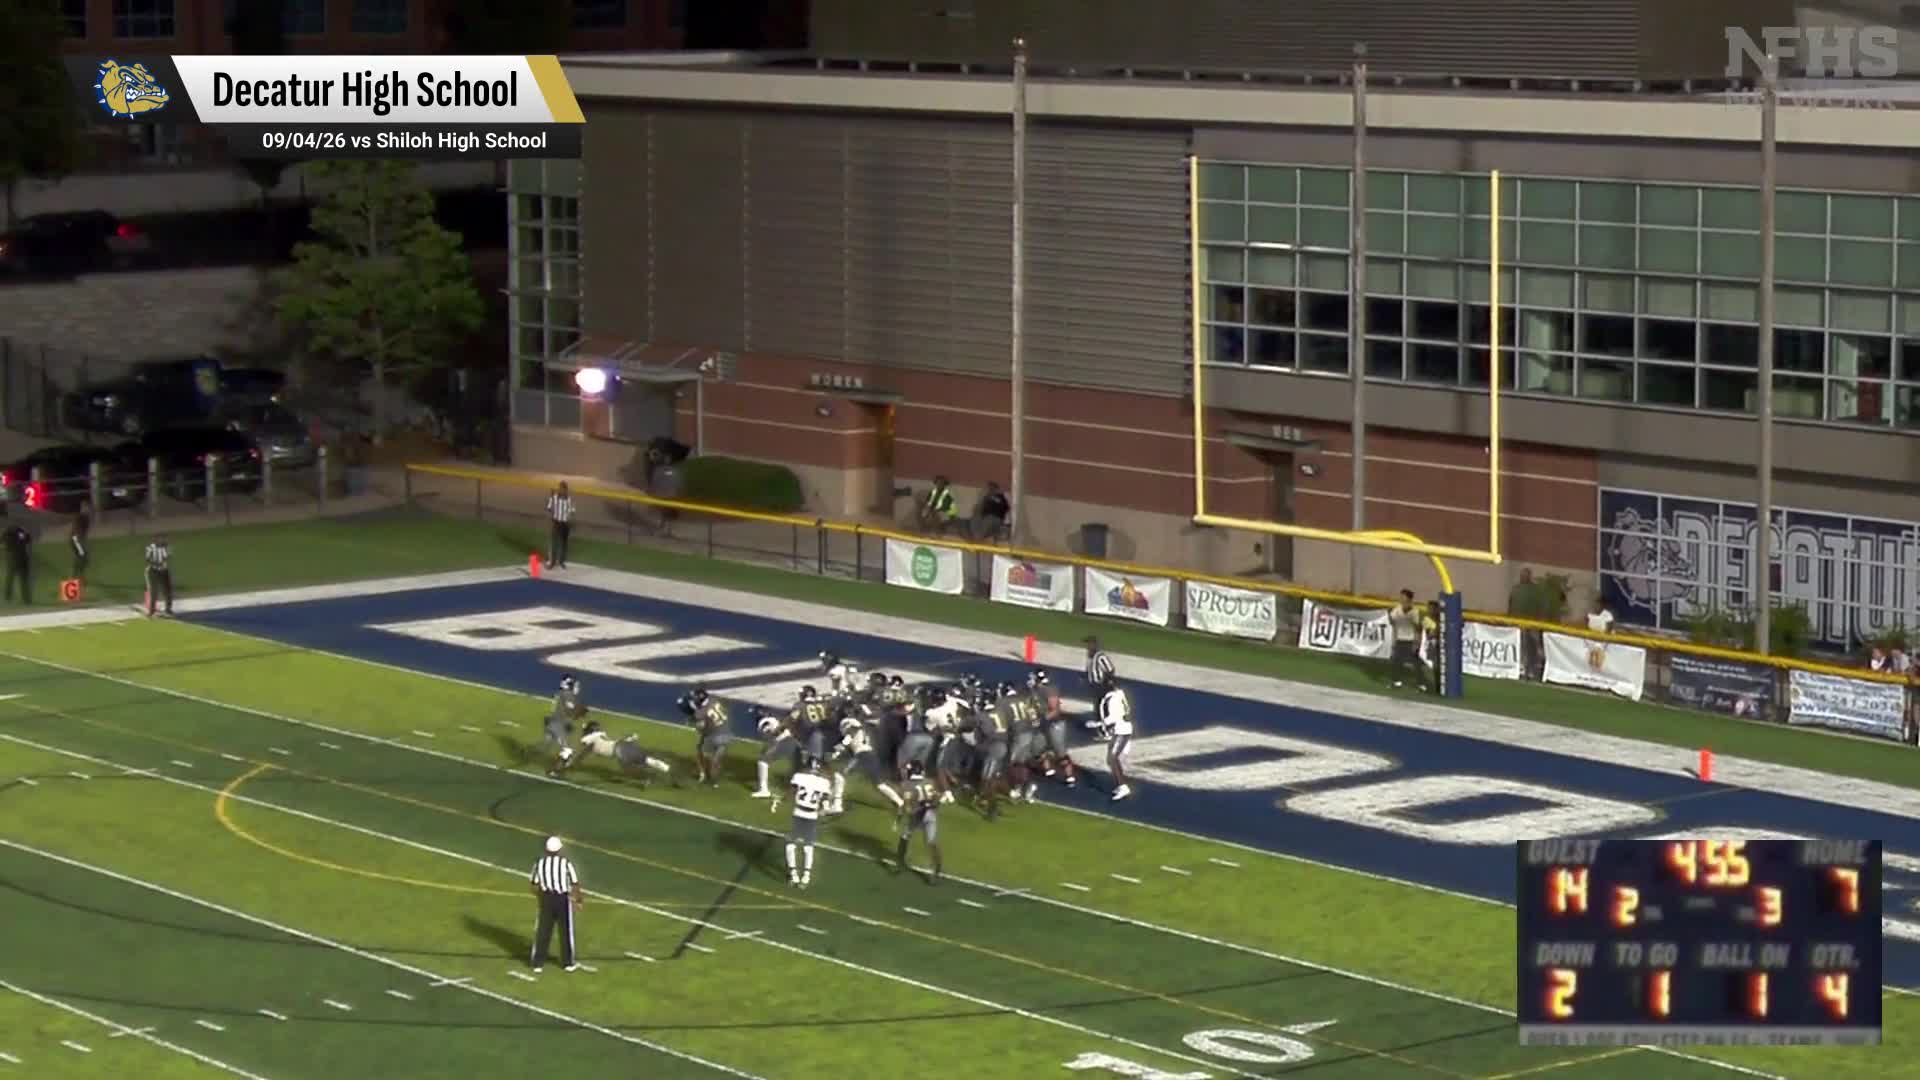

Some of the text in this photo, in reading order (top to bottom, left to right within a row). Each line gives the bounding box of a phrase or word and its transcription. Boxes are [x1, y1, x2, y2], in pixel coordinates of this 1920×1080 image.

[64, 582, 80, 600] G
[1673, 511, 1920, 646] DECATU
[1188, 588, 1272, 621] SPROUTS
[1548, 867, 1589, 912] 14
[1614, 886, 1639, 926] 2
[1757, 886, 1783, 926] 3
[1829, 866, 1860, 912] 7
[1535, 943, 1596, 966] DOWN
[1615, 943, 1679, 966] TO GO
[1702, 943, 1791, 968] BALL ON
[1548, 969, 1577, 1017] 2
[1818, 973, 1849, 1017] 4
